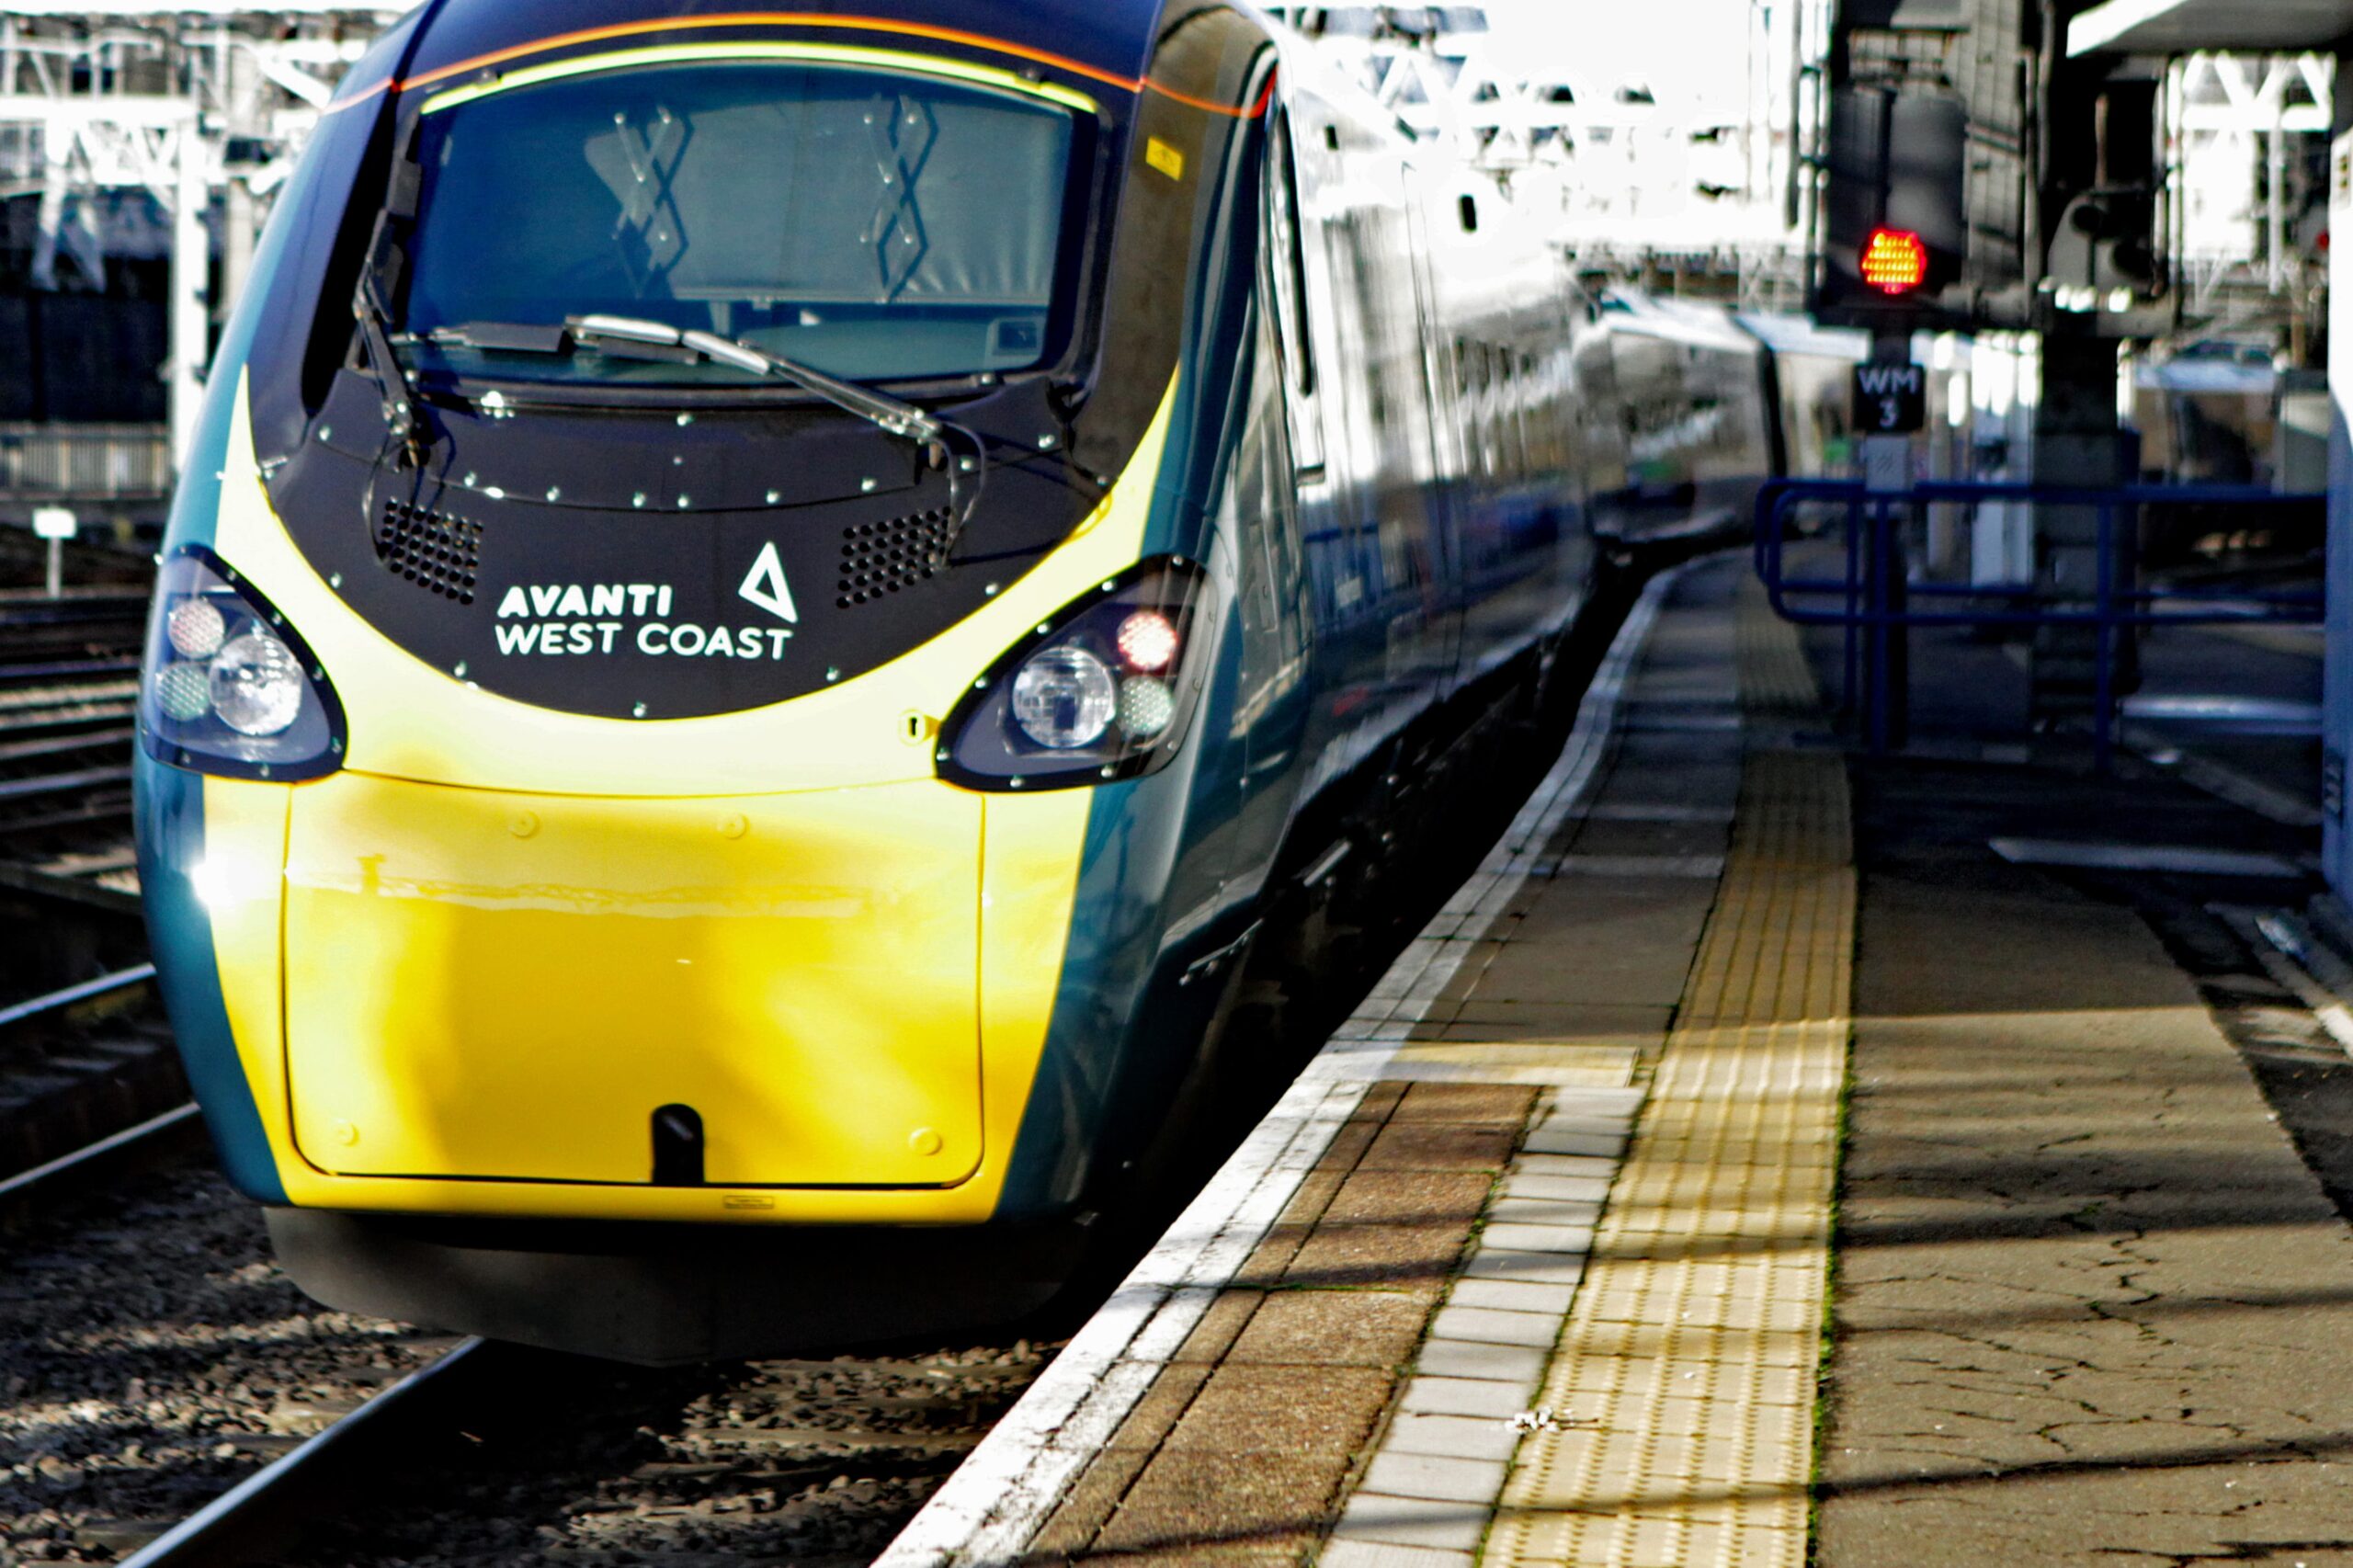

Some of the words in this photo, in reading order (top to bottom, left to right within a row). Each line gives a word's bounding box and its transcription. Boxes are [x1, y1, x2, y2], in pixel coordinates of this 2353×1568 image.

[1858, 367, 1919, 393] WM
[1879, 397, 1897, 428] 3
[496, 584, 673, 619] AVANTI
[494, 622, 623, 655] WEST
[636, 623, 794, 660] COAST
